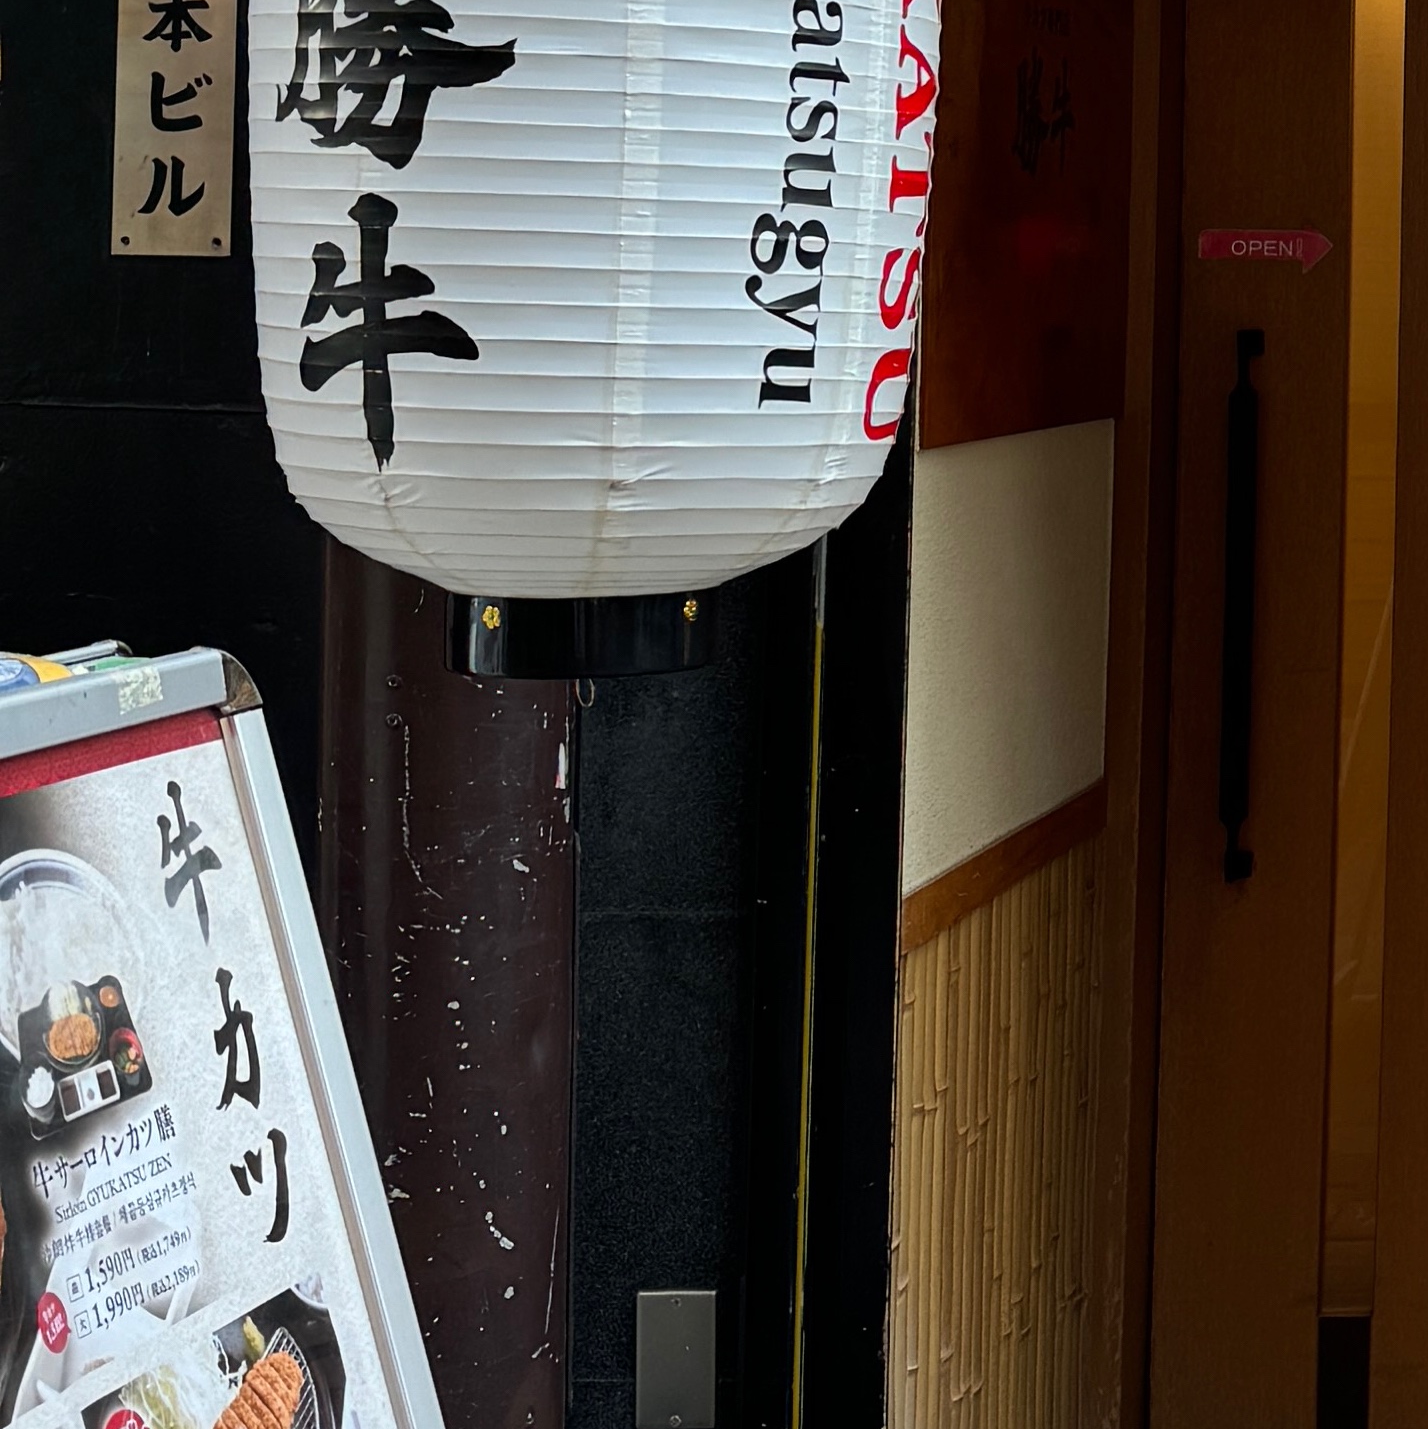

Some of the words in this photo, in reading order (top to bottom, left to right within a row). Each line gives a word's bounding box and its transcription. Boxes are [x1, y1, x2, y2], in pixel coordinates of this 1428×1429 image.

[156, 780, 291, 1244] 牛カツ
[32, 1103, 176, 1199] 牛サーロインカツ膳
[86, 1165, 147, 1210] GYUKATSU
[148, 1152, 173, 1179] ZEN
[84, 1246, 135, 1294] 1,590円
[92, 1281, 146, 1330] 1,990円
